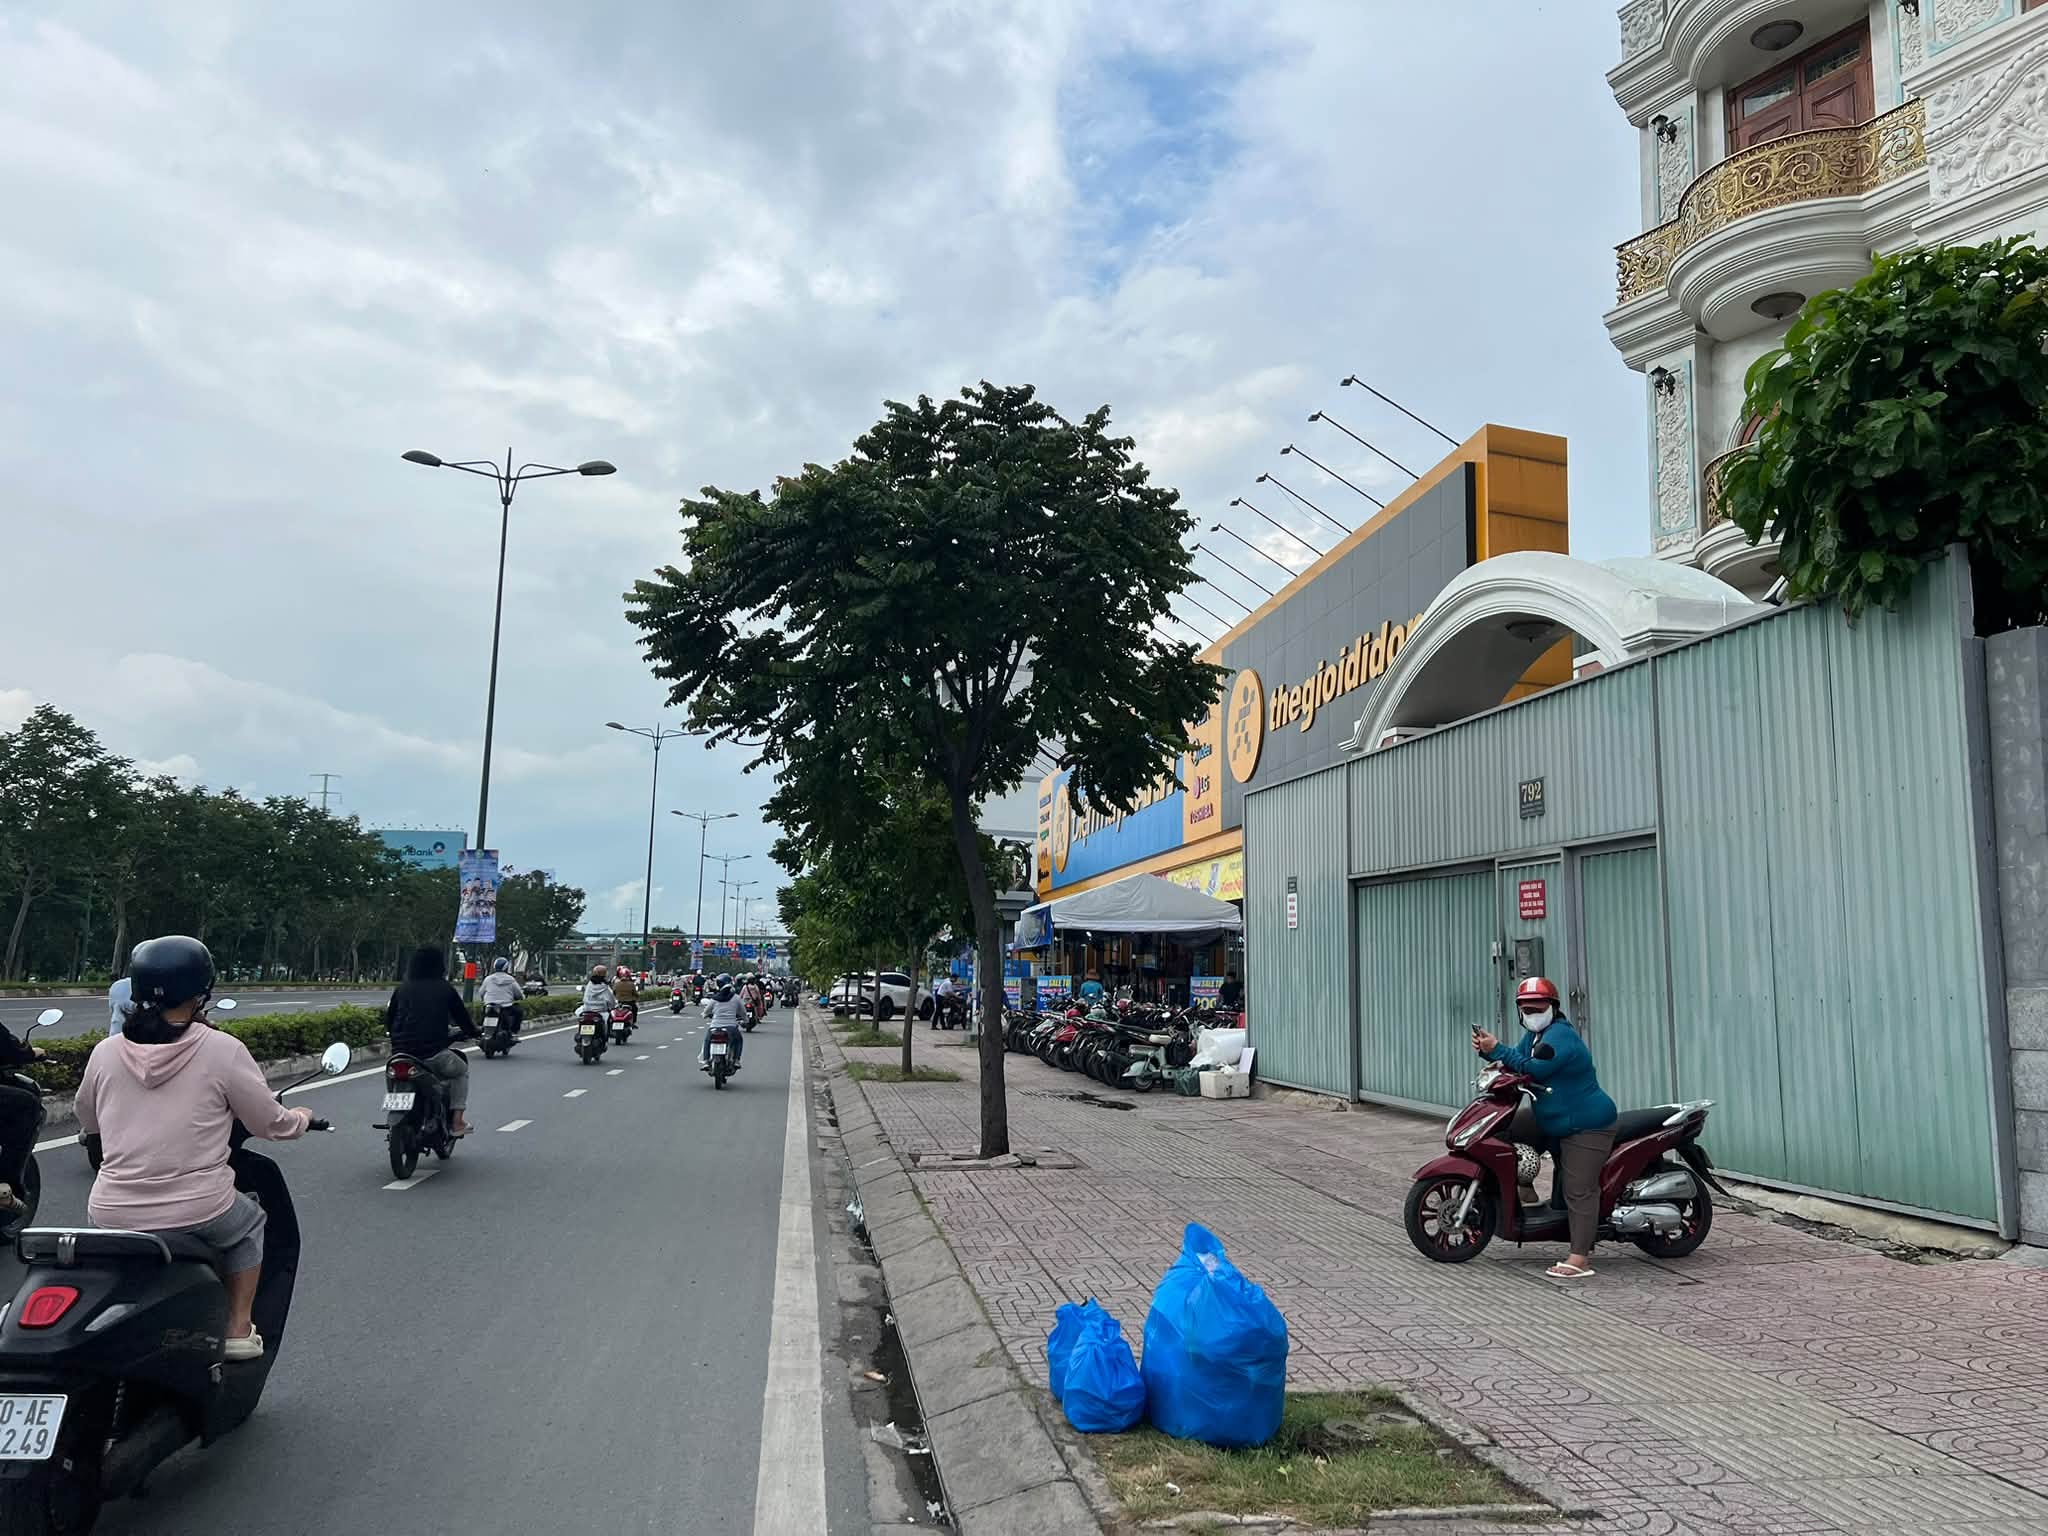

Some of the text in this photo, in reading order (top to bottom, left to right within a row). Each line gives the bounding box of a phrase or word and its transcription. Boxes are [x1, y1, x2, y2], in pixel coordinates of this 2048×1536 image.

[1521, 781, 1542, 803] 792
[0, 1399, 53, 1425] 0-AE
[0, 1428, 49, 1455] 2.49
